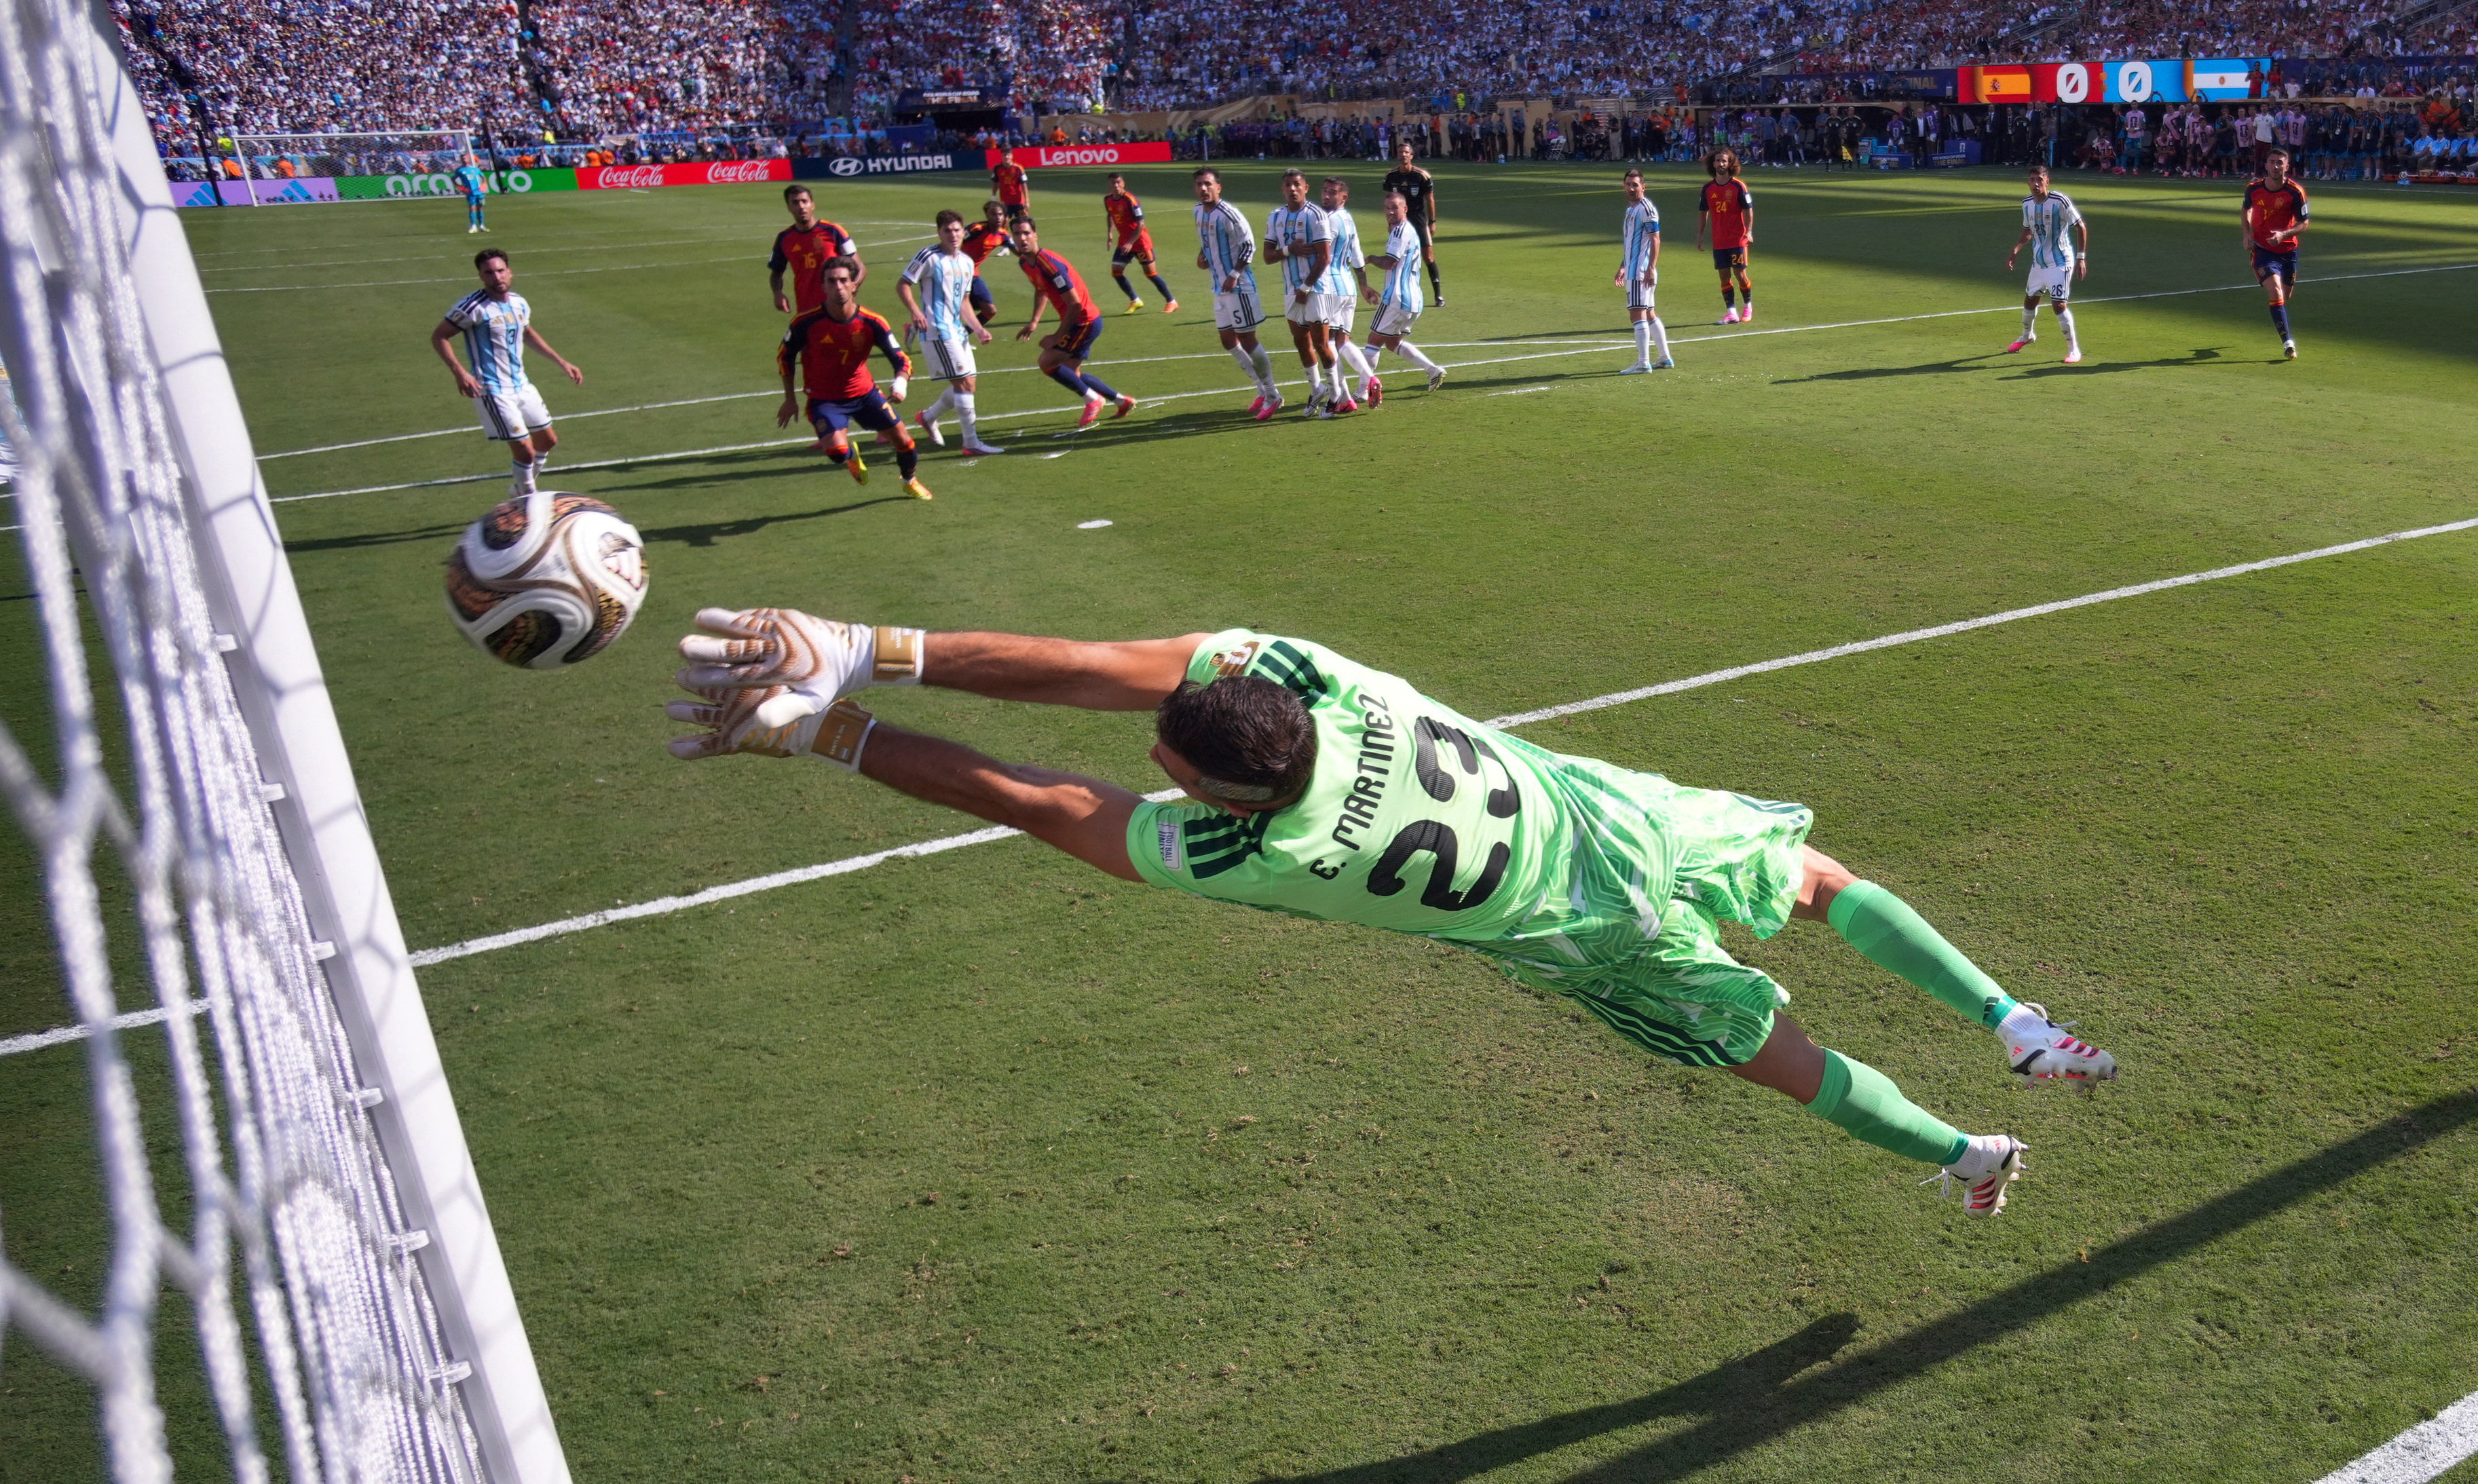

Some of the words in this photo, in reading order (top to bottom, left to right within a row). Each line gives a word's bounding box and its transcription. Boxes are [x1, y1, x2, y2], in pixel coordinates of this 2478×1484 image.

[2057, 63, 2088, 103] 0
[2118, 61, 2152, 102] 0
[867, 155, 953, 172] HYUNDAI
[1040, 147, 1119, 166] Lenovo
[597, 164, 666, 189] Coca-Cola
[707, 159, 770, 183] Coca-Cola
[385, 170, 532, 198] araco
[1716, 202, 1727, 212] 24
[804, 253, 817, 269] 16
[1731, 254, 1744, 265] 24
[954, 282, 960, 297] 9
[2051, 284, 2063, 297] 26
[1233, 309, 1242, 324] 5
[508, 328, 515, 345] 3
[839, 349, 850, 365] 7
[882, 402, 897, 420] 7
[1309, 858, 1347, 880] E.
[1332, 693, 1395, 851] MARTINEZ
[1366, 715, 1521, 911] 23
[1165, 831, 1174, 862] FOOTBALL
